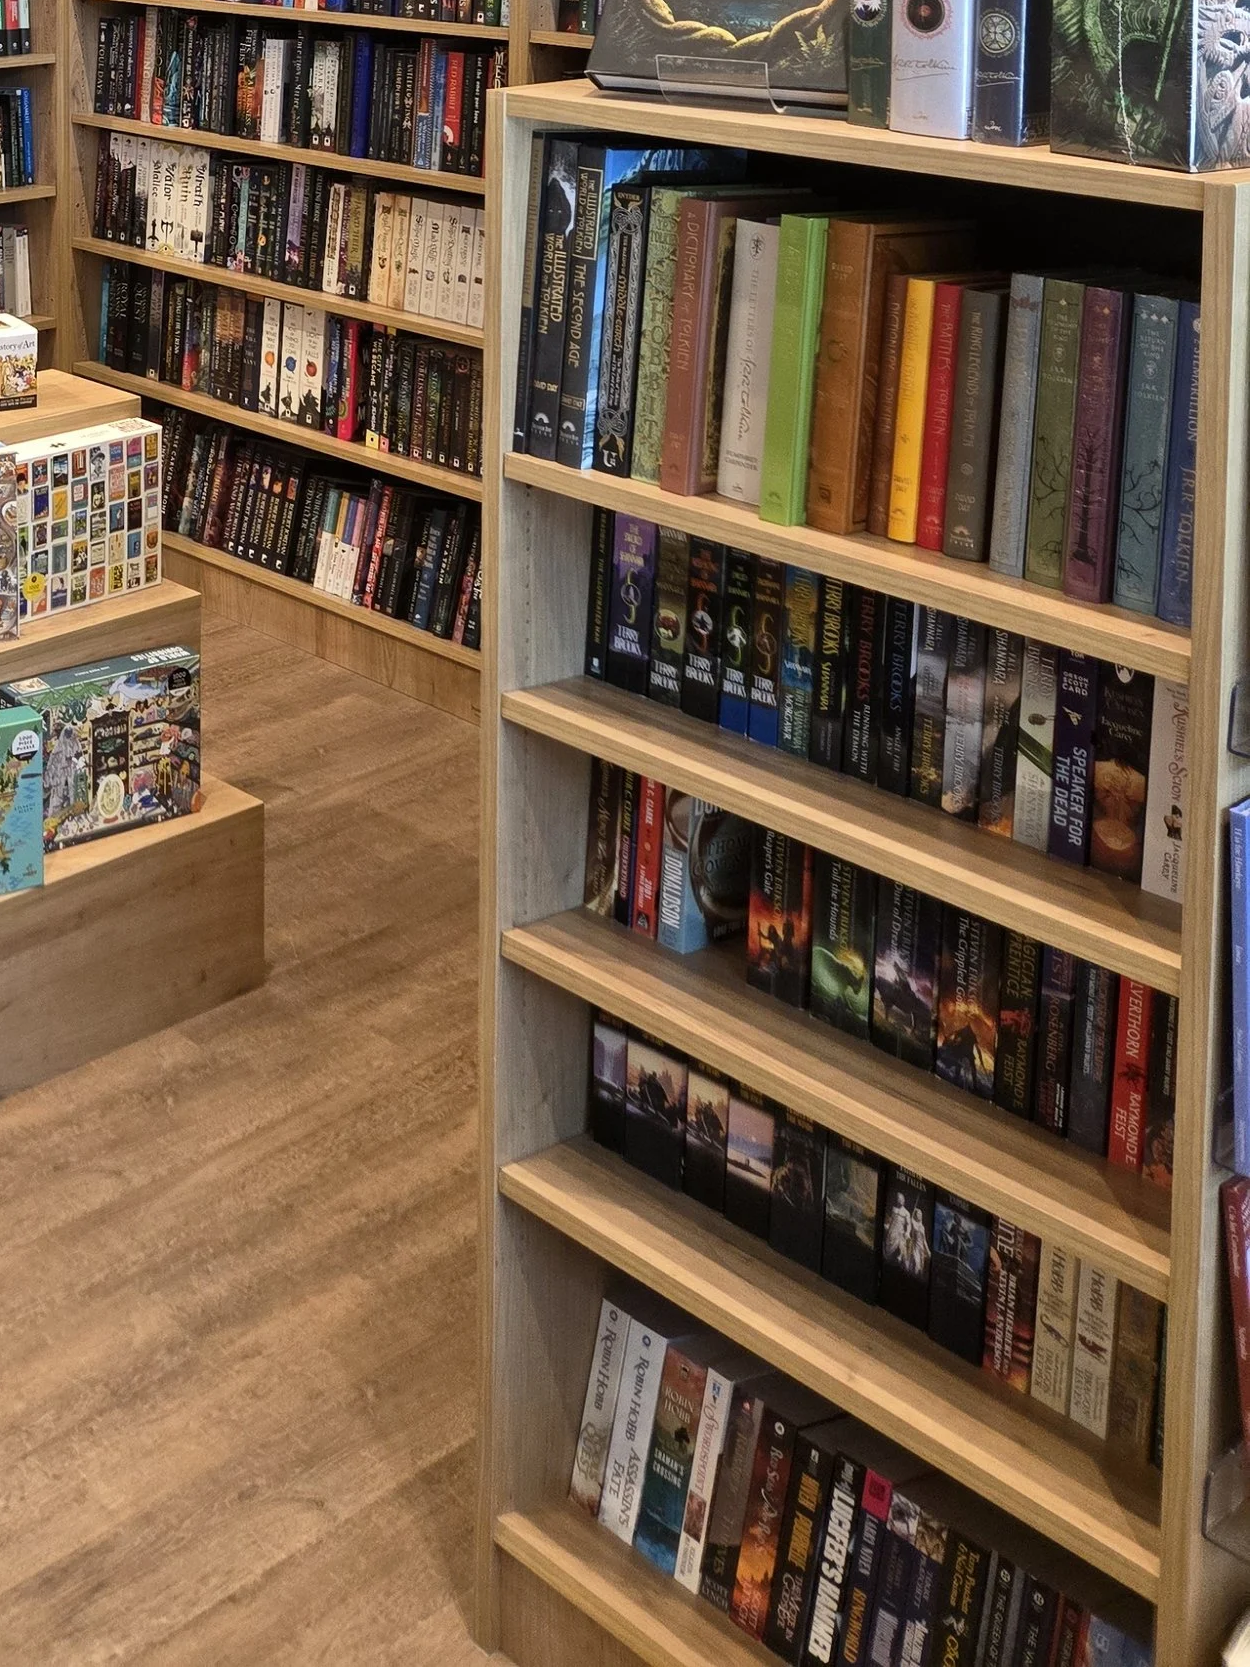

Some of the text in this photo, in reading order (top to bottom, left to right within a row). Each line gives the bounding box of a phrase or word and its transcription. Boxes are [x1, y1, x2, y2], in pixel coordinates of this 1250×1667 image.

[551, 251, 567, 323] ILLUSTRATED
[571, 292, 584, 340] SECOND
[675, 221, 699, 373] DICTIONARY TOLKIEN
[24, 340, 36, 349] Art
[1062, 684, 1089, 697] CARD
[1053, 754, 1070, 827] THE DEAD
[1067, 746, 1088, 847] SPEAKER FOR
[660, 854, 683, 929] DONALDSON
[608, 1458, 626, 1501] FATE
[618, 1447, 642, 1529] ASSASSIN'S
[807, 1487, 857, 1665] LUCIFER'S HAMMER
